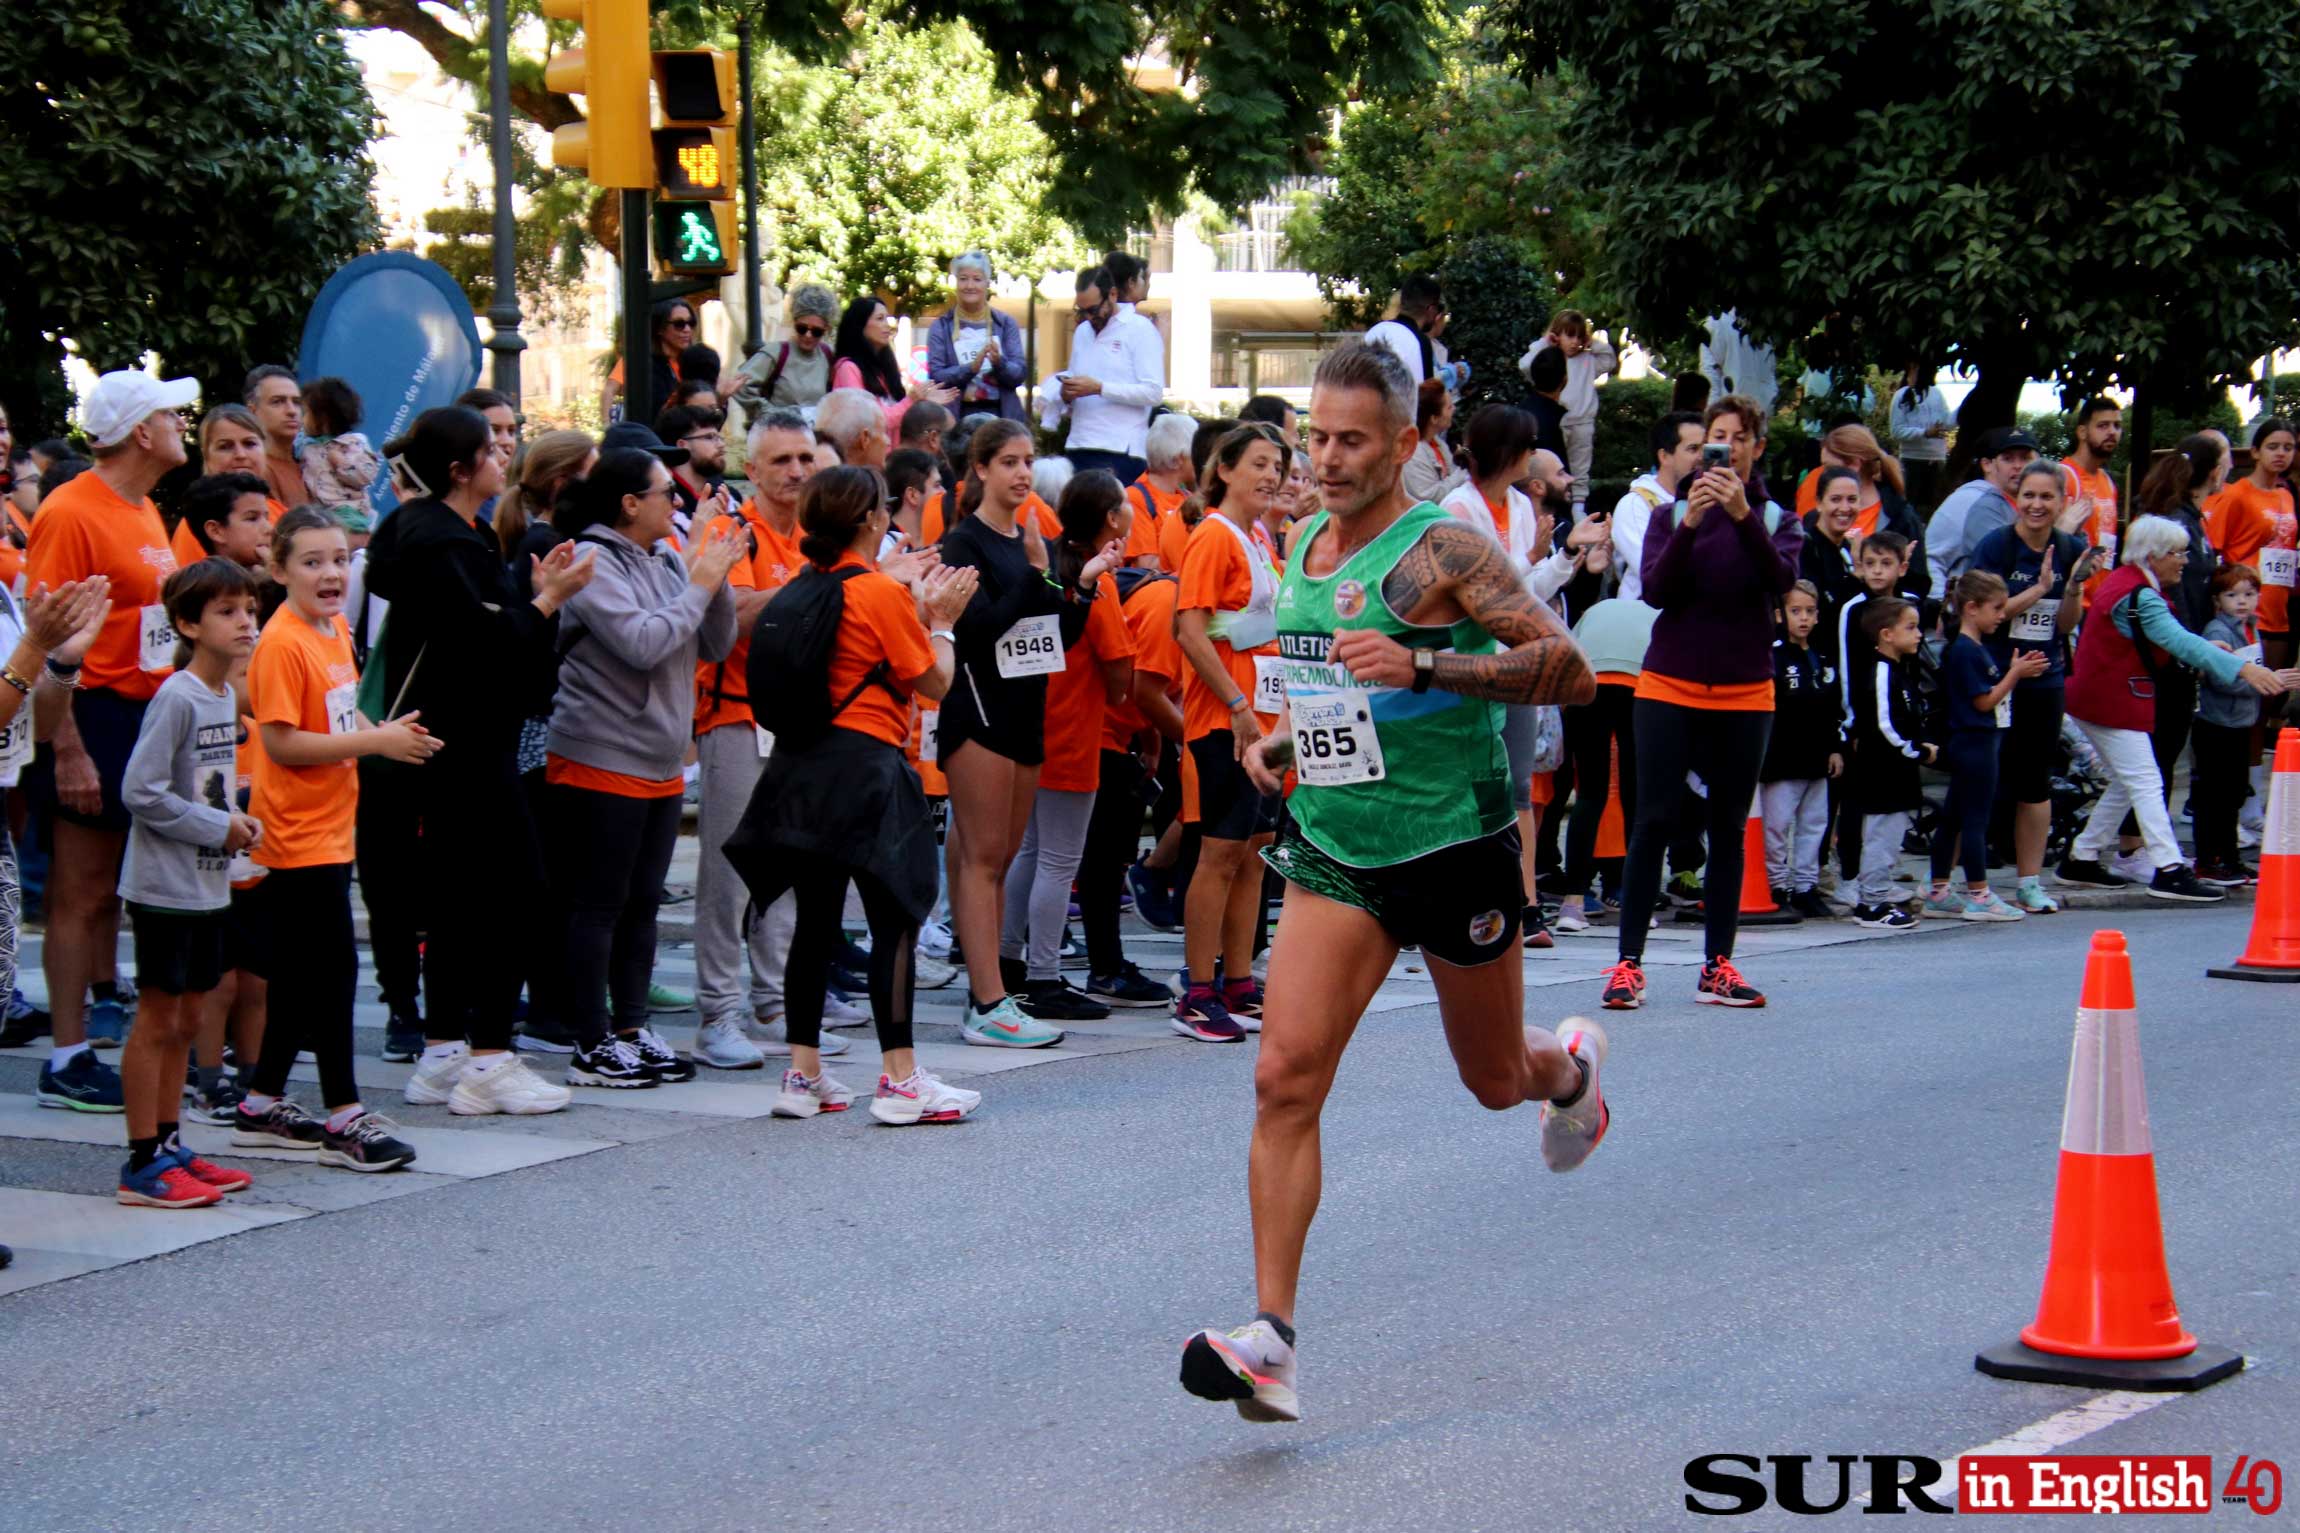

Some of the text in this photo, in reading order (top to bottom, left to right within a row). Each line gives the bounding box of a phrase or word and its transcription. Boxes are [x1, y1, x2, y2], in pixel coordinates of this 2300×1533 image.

[678, 145, 718, 188] 48
[404, 384, 420, 402] de
[2265, 561, 2292, 573] 187
[1002, 636, 1055, 657] 1948
[1298, 726, 1357, 758] 365
